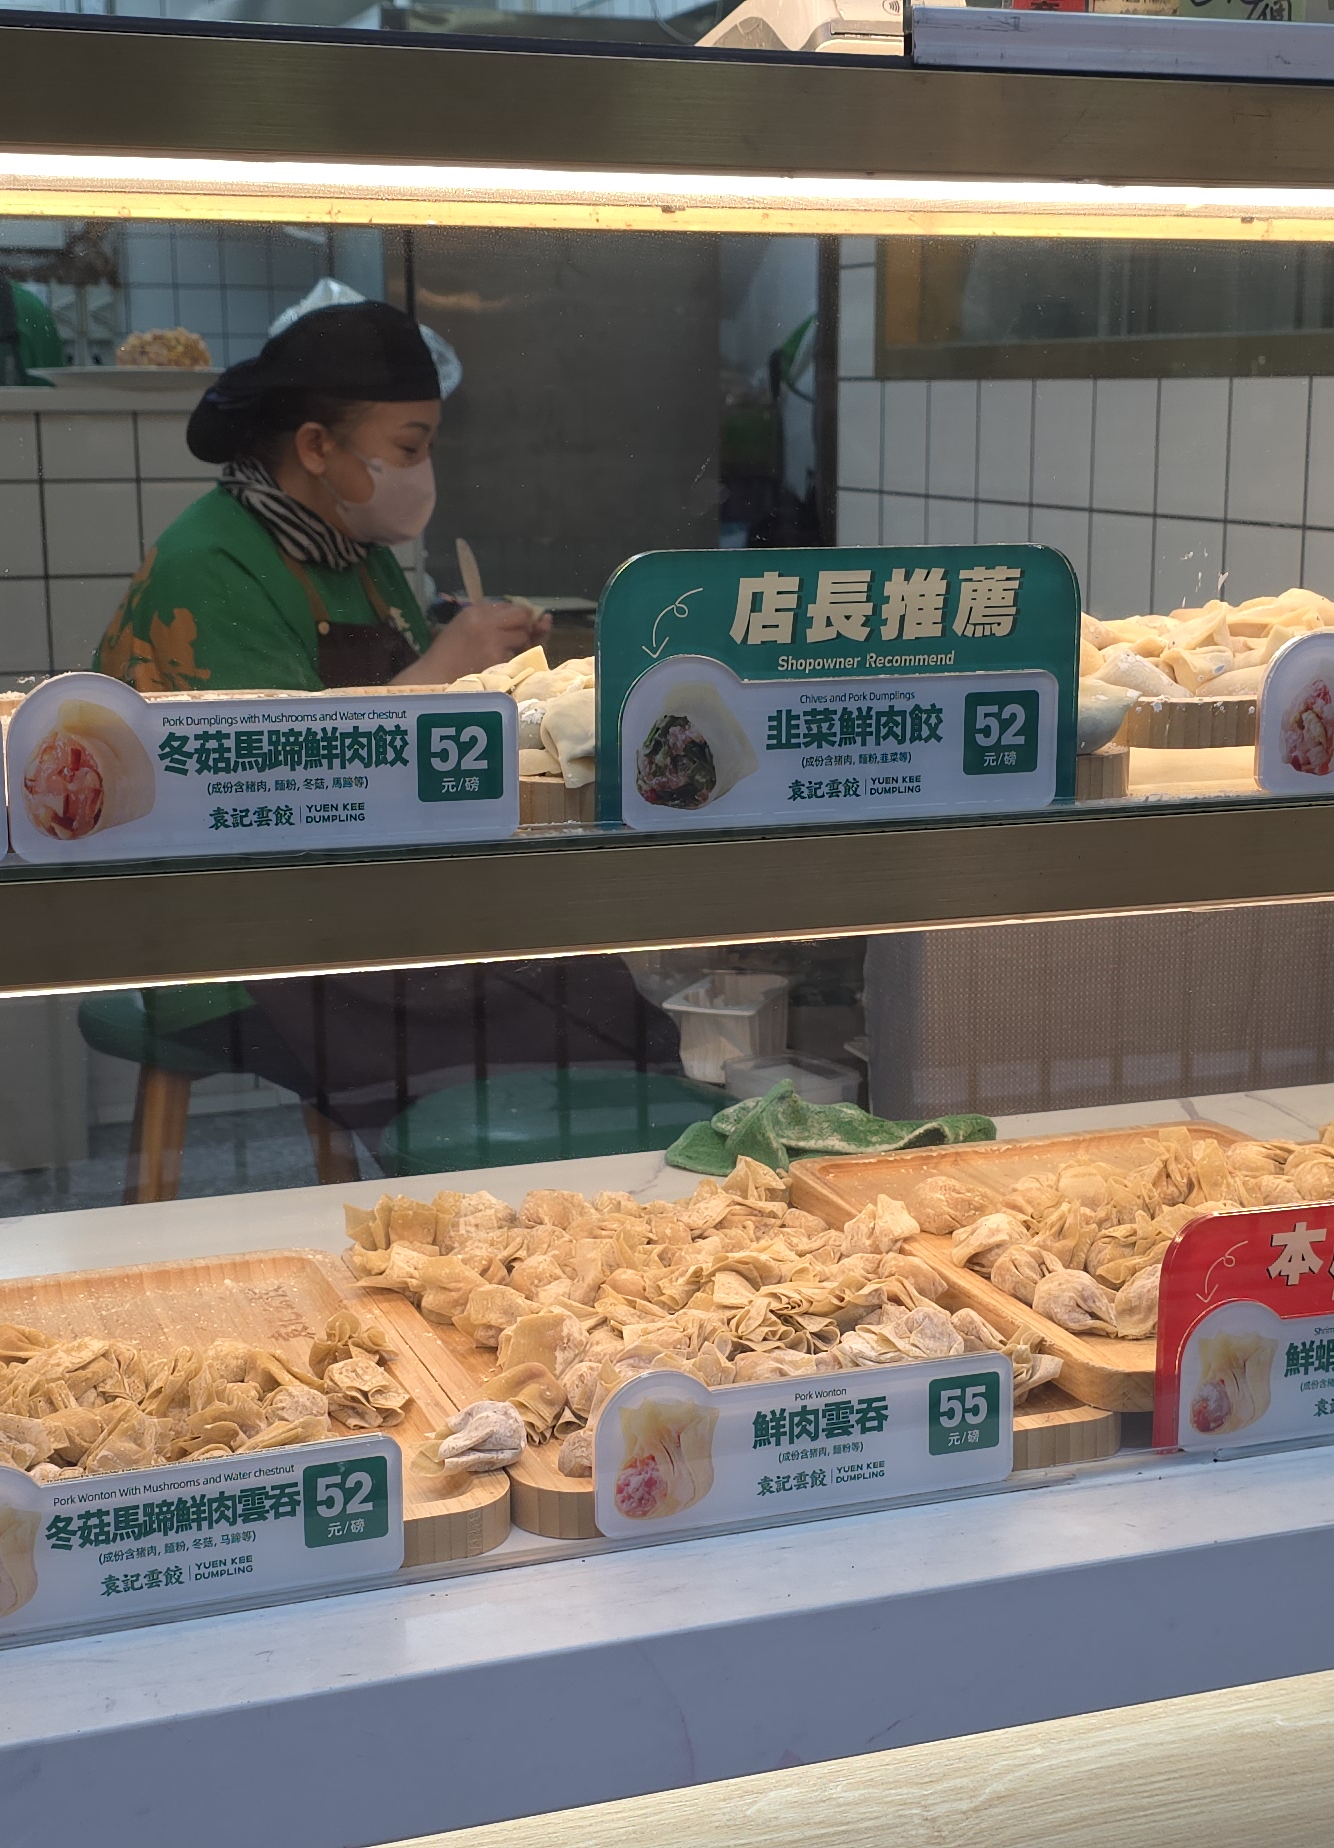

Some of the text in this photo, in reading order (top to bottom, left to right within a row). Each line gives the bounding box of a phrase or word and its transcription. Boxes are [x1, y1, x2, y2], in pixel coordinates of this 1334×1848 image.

[729, 566, 1024, 646] 店長推薦
[777, 650, 955, 673] Shopowner Recommend
[800, 691, 915, 704] Chives and Pork Dumplings
[162, 709, 407, 728] Pork Dumplings with Mushrooms and Water chestnut
[766, 703, 944, 750] 韭菜鮮肉餃
[975, 703, 1026, 747] 52
[158, 724, 410, 777] 冬菇馬蹄鮮肉餃
[429, 725, 489, 772] 52
[983, 751, 1017, 767] 元/磅
[442, 777, 481, 793] 元/磅
[787, 777, 861, 801] 袁記雲餃
[870, 775, 921, 785] YUEN KEE
[870, 785, 921, 796] DUMPLING
[209, 804, 296, 830] 袁記雲餃
[305, 802, 365, 813] YUEN KEE
[305, 813, 366, 824] DUMPLING
[795, 1389, 847, 1401] Pork Wonton
[939, 1385, 988, 1428] 55
[752, 1396, 889, 1449] 鮮肉雲吞
[947, 1430, 980, 1446] 元/磅
[835, 1470, 885, 1484] DUMPLING
[836, 1461, 885, 1474] YUEN KEE
[53, 1464, 295, 1506] Pork Wonton With Mushrooms and Water chestnut
[757, 1468, 828, 1497] 袁記雲餃
[317, 1473, 373, 1517] 52
[45, 1482, 301, 1551] 冬菇馬蹄鮮肉雲吞
[327, 1519, 366, 1538] 元/磅
[195, 1555, 253, 1571] YUEN KEE
[195, 1565, 253, 1581] DUMPLING
[101, 1566, 184, 1597] 袁記雲餃
